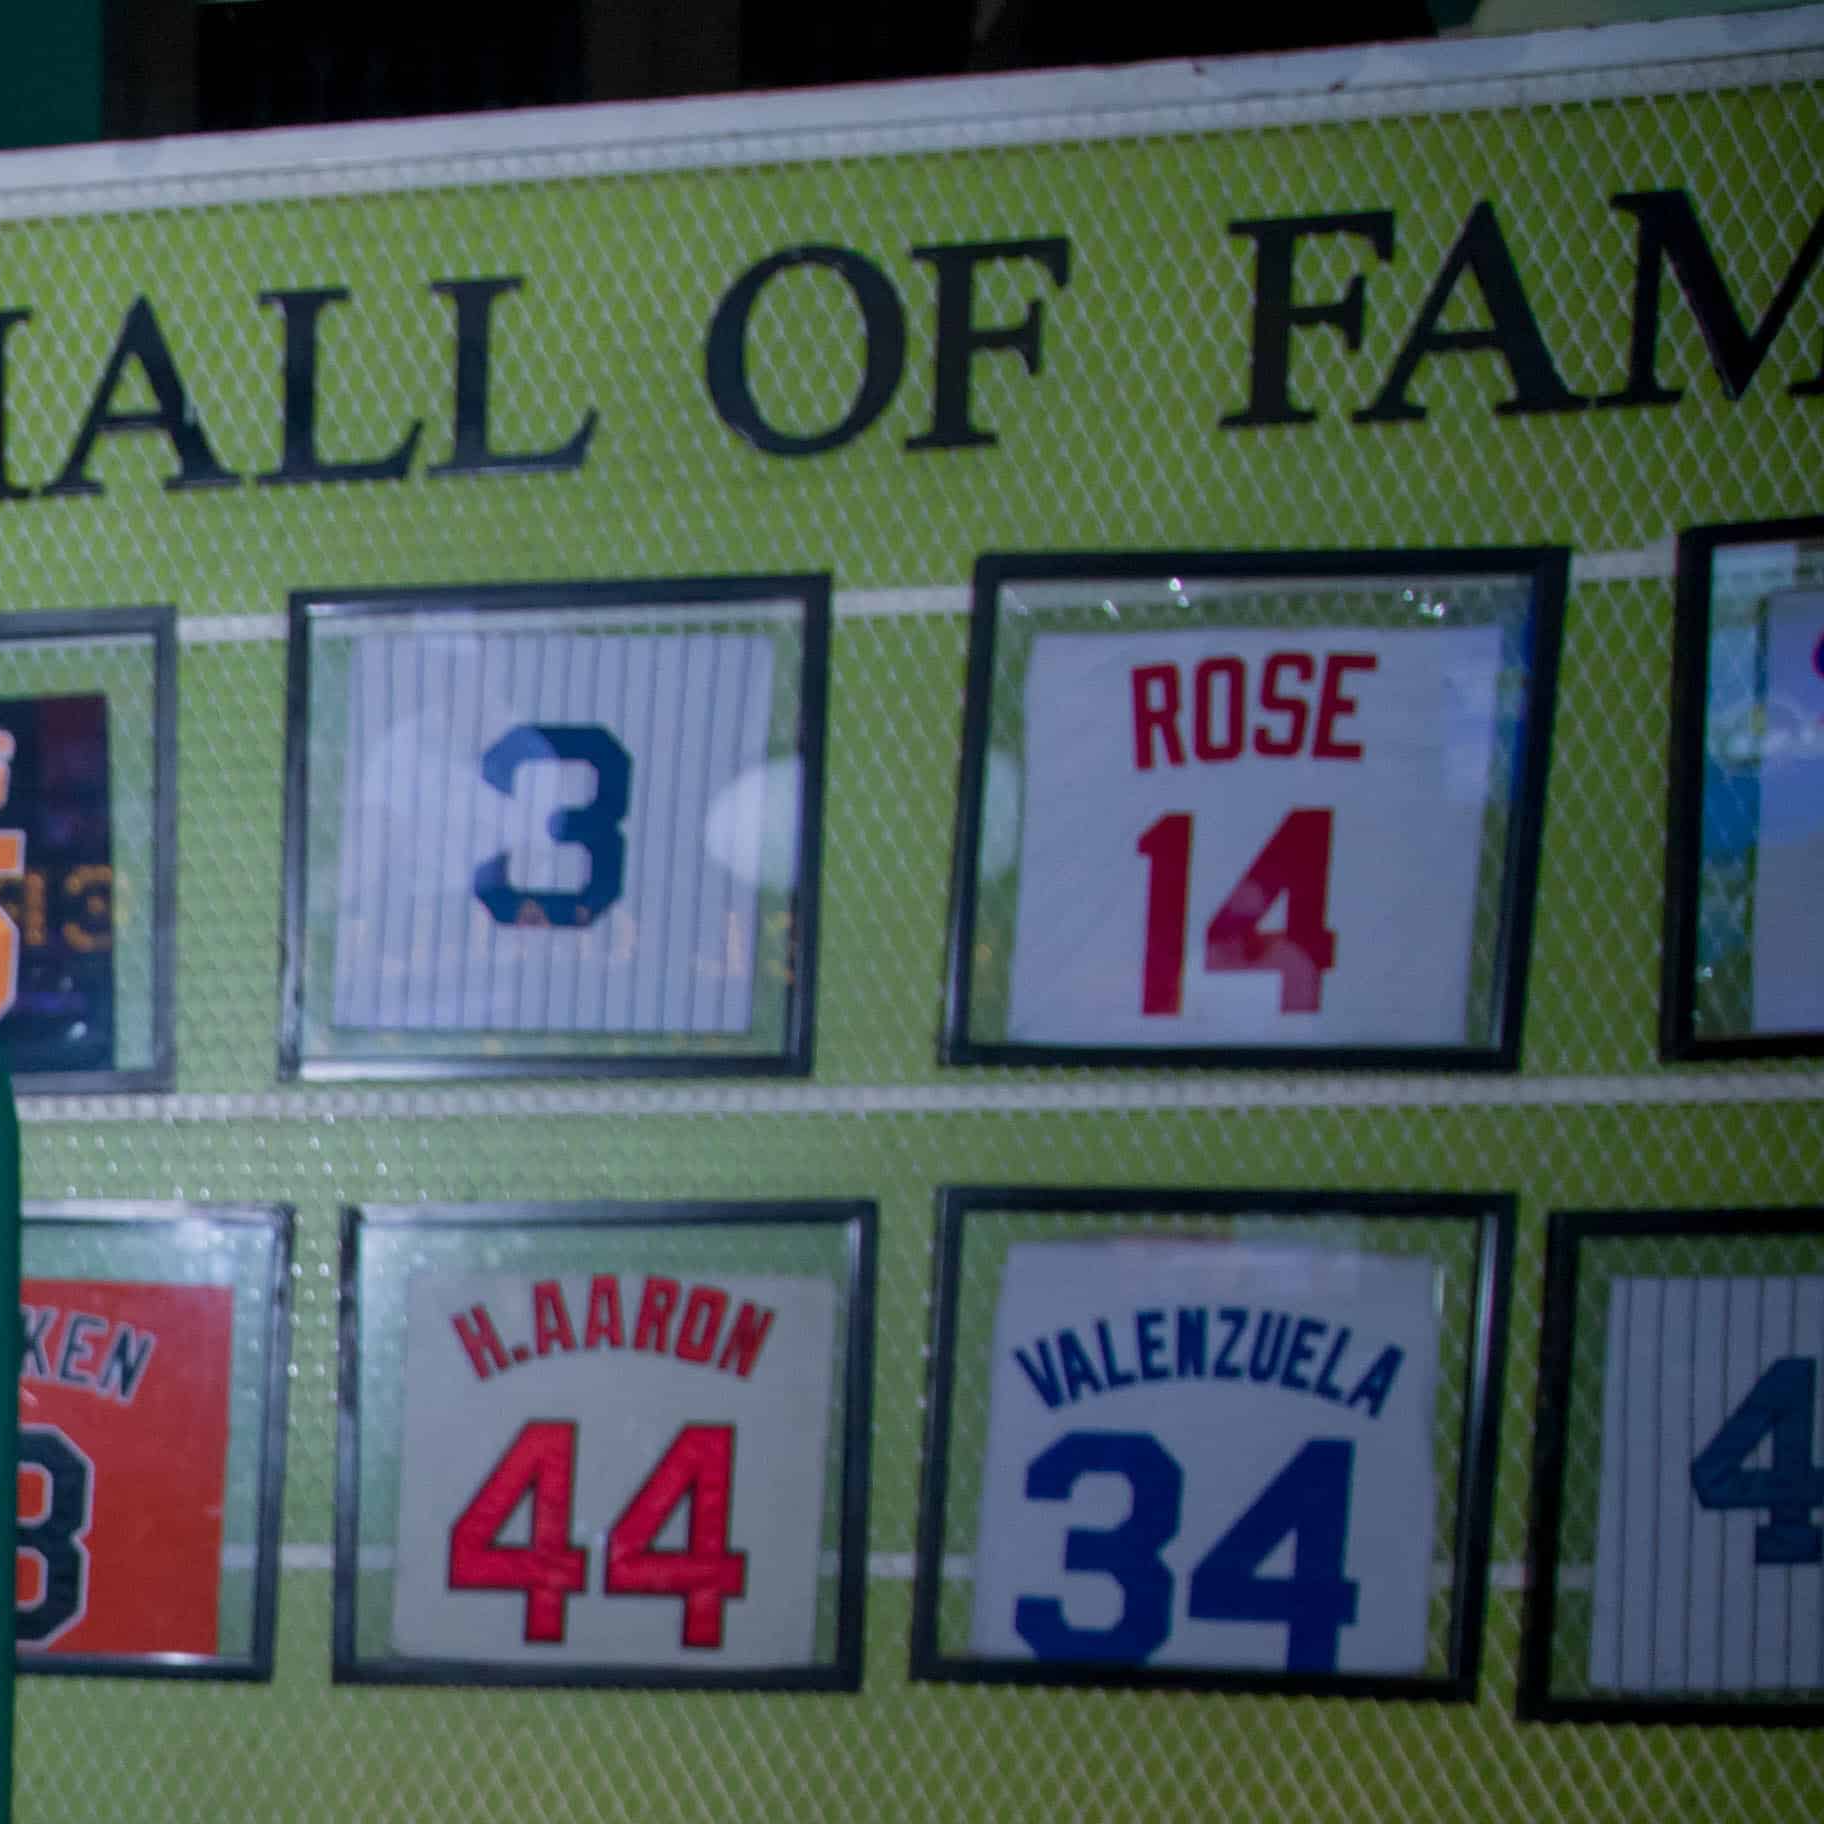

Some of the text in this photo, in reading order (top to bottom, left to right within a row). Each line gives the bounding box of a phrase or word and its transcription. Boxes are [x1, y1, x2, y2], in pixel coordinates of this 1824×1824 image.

[705, 234, 1071, 457] OF
[1130, 650, 1379, 772] ROSE
[473, 721, 634, 929] 3
[1136, 806, 1338, 1017] 14
[452, 1272, 776, 1382] H.AARON
[1012, 1306, 1406, 1419] VALENZUELA
[448, 1418, 749, 1650] 44
[1014, 1430, 1360, 1673] 34
[1689, 1356, 1824, 1566] 4
